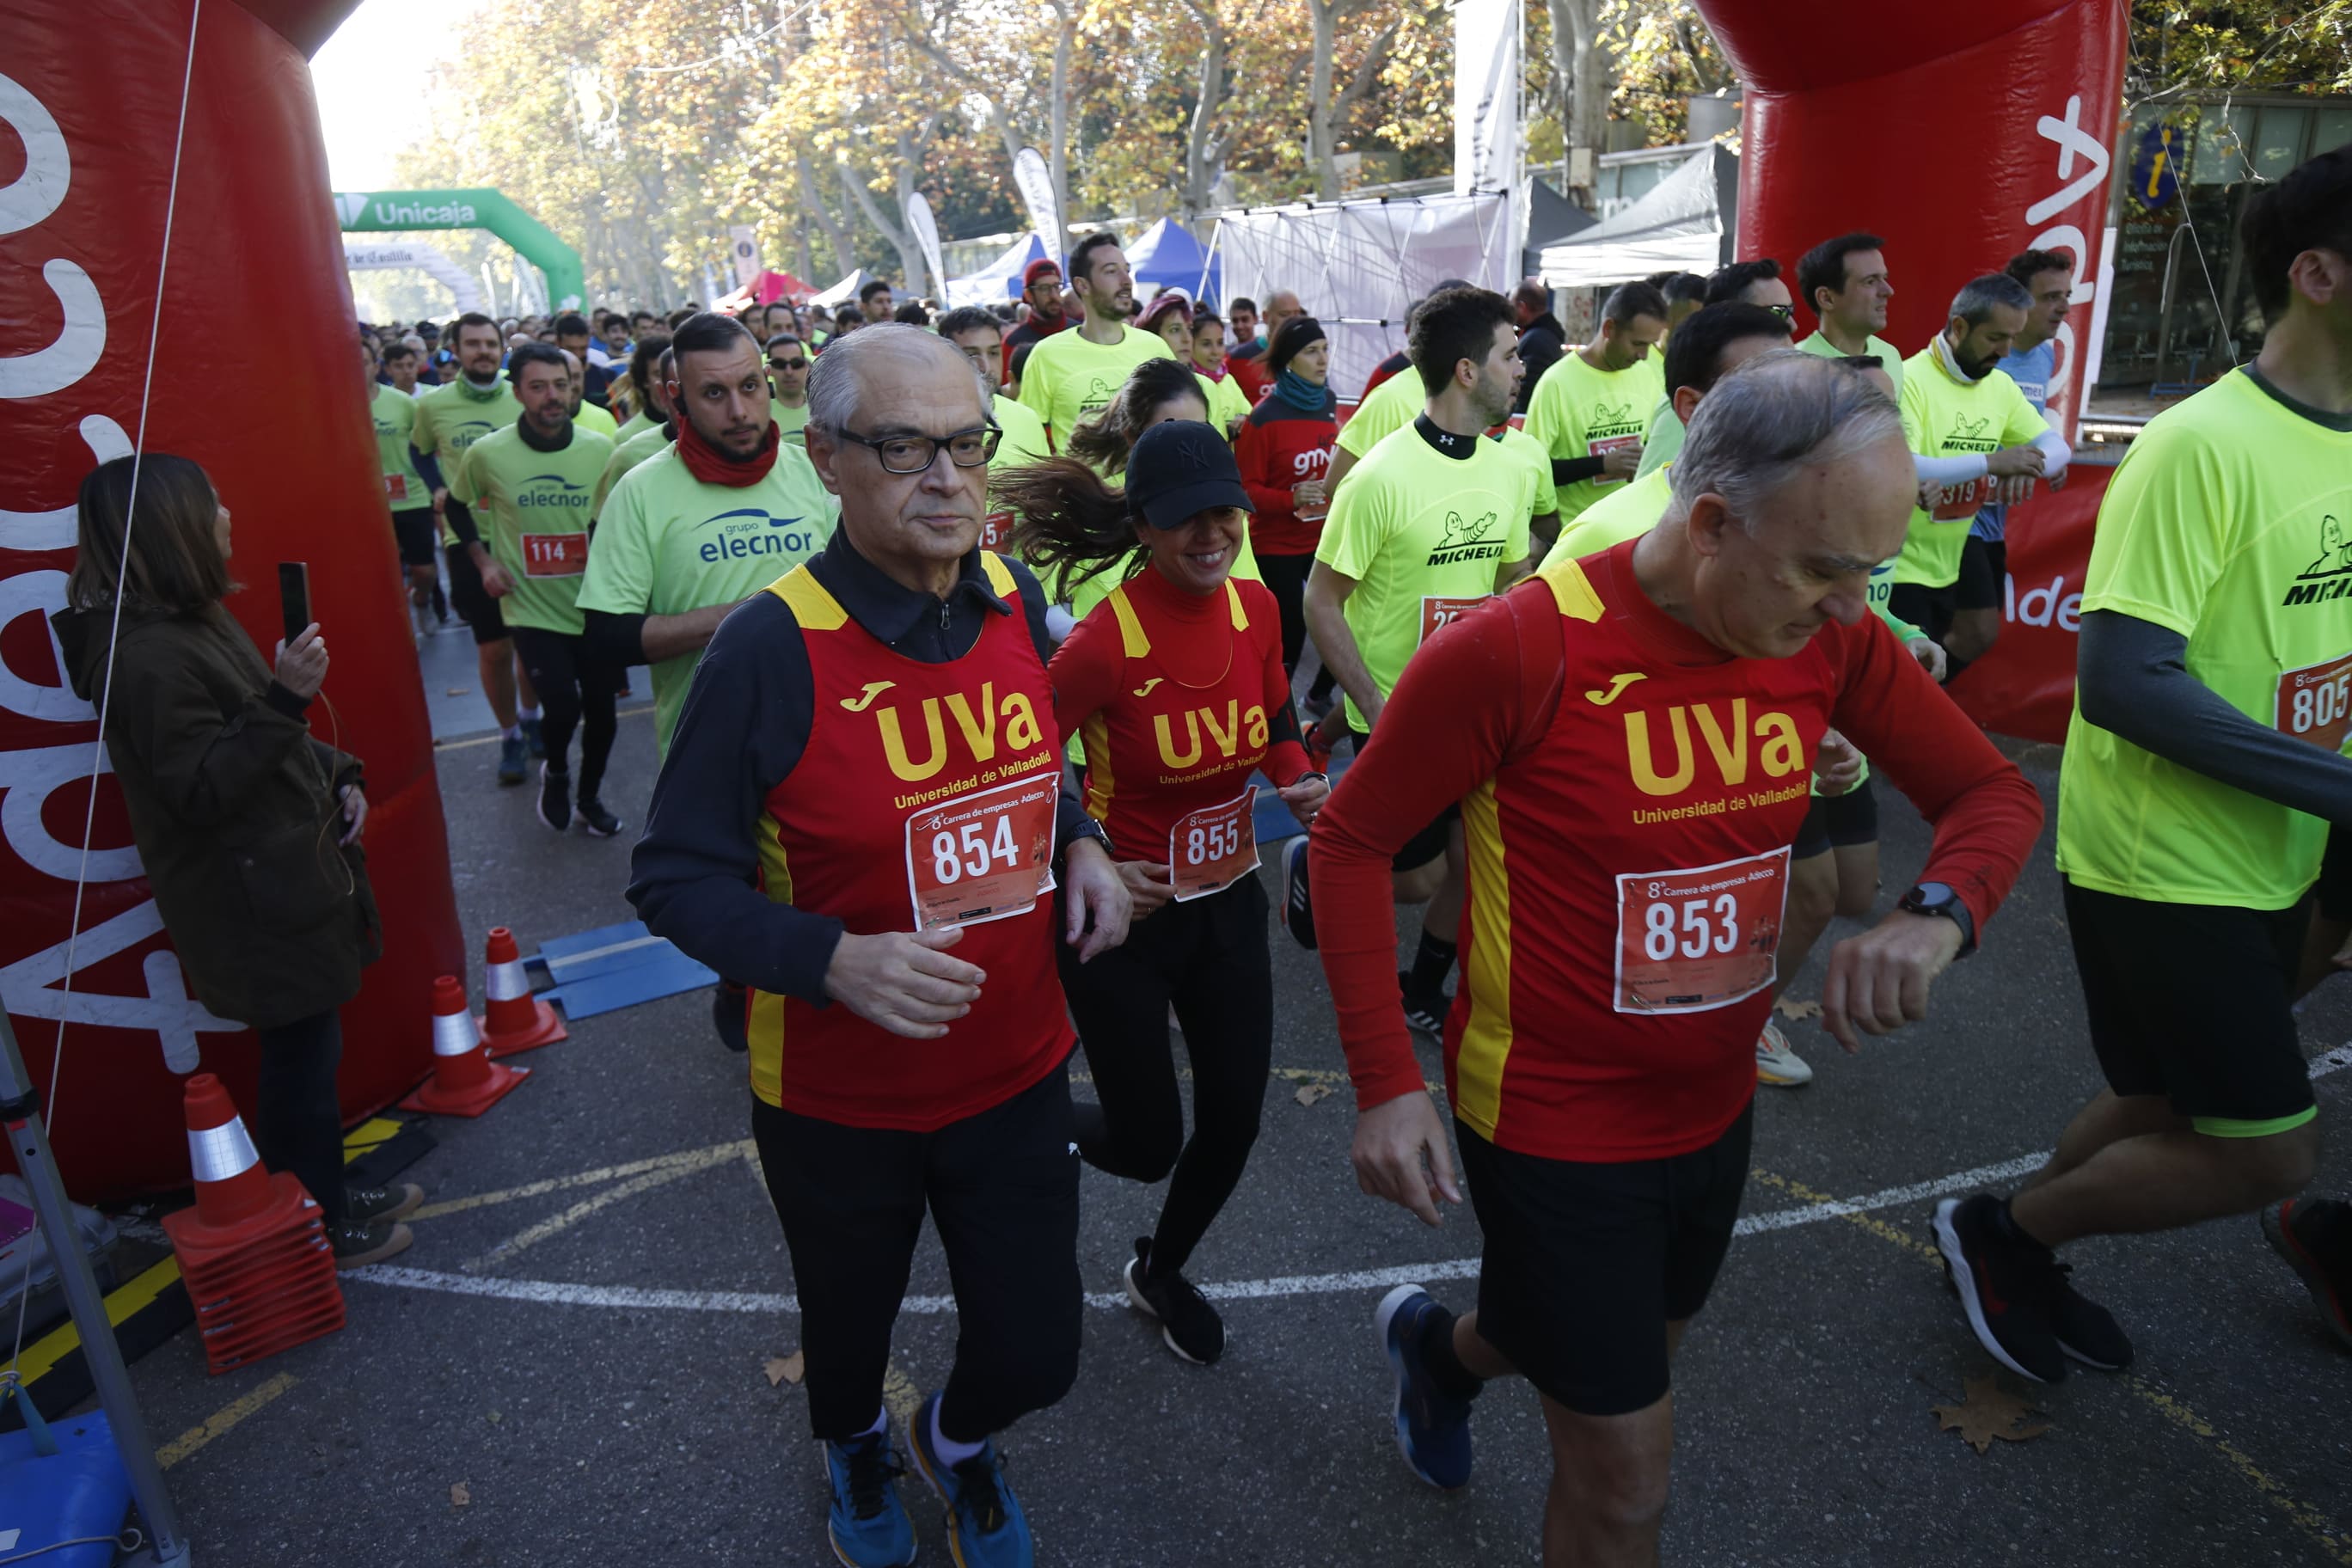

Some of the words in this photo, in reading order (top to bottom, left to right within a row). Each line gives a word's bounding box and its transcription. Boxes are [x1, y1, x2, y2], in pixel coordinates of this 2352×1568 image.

[375, 200, 477, 226] Unicaja
[518, 490, 591, 508] elecnor
[725, 520, 759, 535] grupo
[530, 542, 566, 562] 114
[699, 531, 813, 563] elecnor
[2293, 673, 2351, 733] 805
[875, 681, 1044, 782] UVa
[1153, 698, 1269, 769] UVa
[1623, 697, 1805, 796] UVa
[894, 775, 978, 810] Universidad
[981, 770, 997, 784] de
[997, 750, 1052, 778] Valladolid
[1160, 764, 1221, 784] Universidad
[1222, 762, 1235, 771] de
[942, 812, 972, 826] Carrera
[971, 808, 983, 818] de
[983, 799, 1020, 815] empresas
[1020, 791, 1045, 805] Adecco
[1632, 799, 1726, 824] Universidad
[1729, 797, 1747, 811] de
[932, 814, 1020, 885] 854
[1187, 818, 1239, 866] 855
[1663, 885, 1699, 897] Carrera
[1698, 883, 1711, 893] de
[1709, 875, 1747, 892] empresas
[1644, 892, 1739, 962] 853
